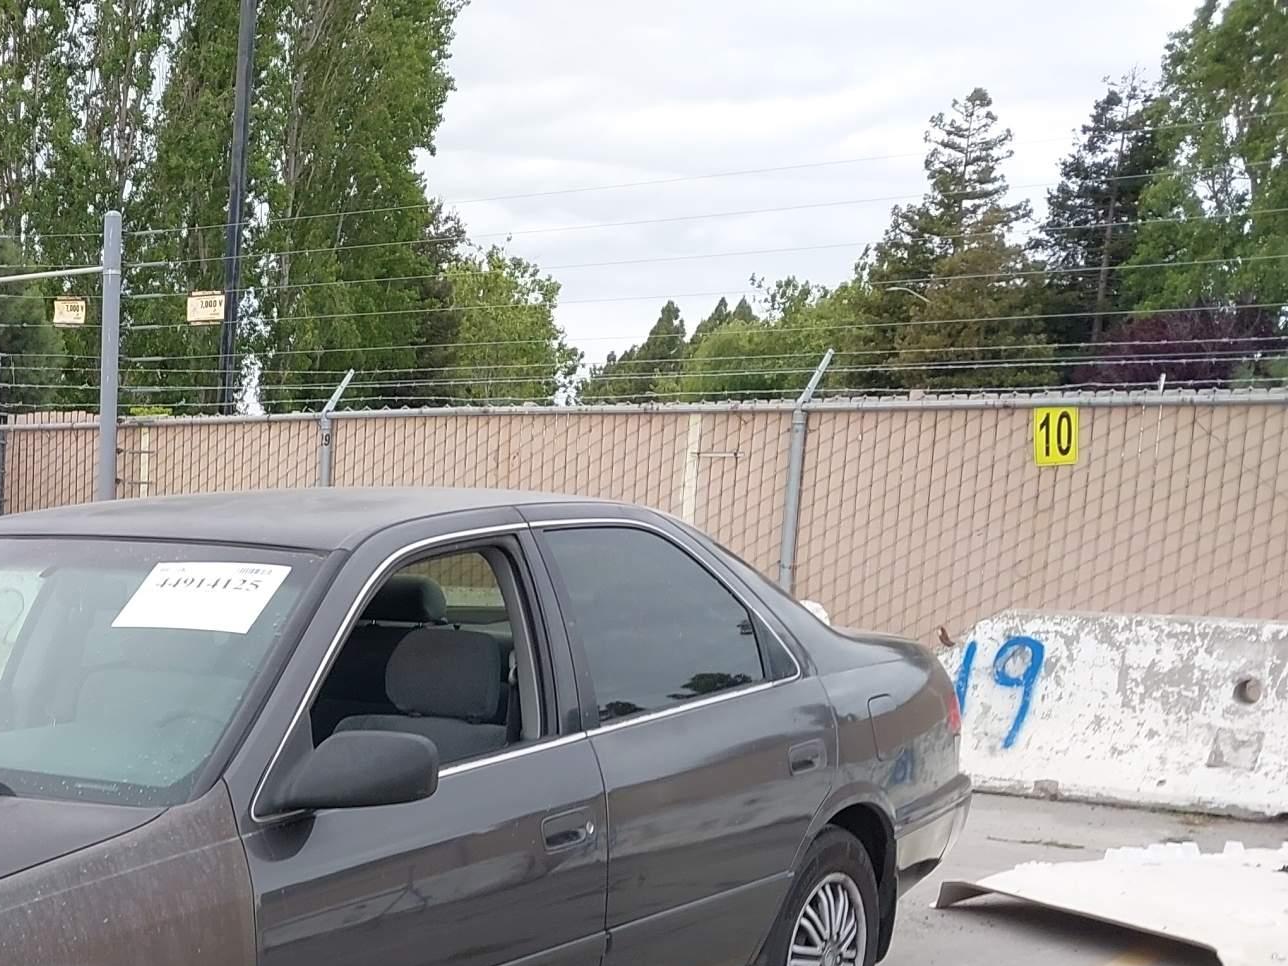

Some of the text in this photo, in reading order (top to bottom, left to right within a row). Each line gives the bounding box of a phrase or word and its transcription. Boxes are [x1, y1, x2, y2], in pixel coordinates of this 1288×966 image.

[200, 299, 218, 309] 7,000
[320, 433, 331, 447] 19
[1039, 409, 1073, 457] 10
[155, 576, 264, 592] 44914125
